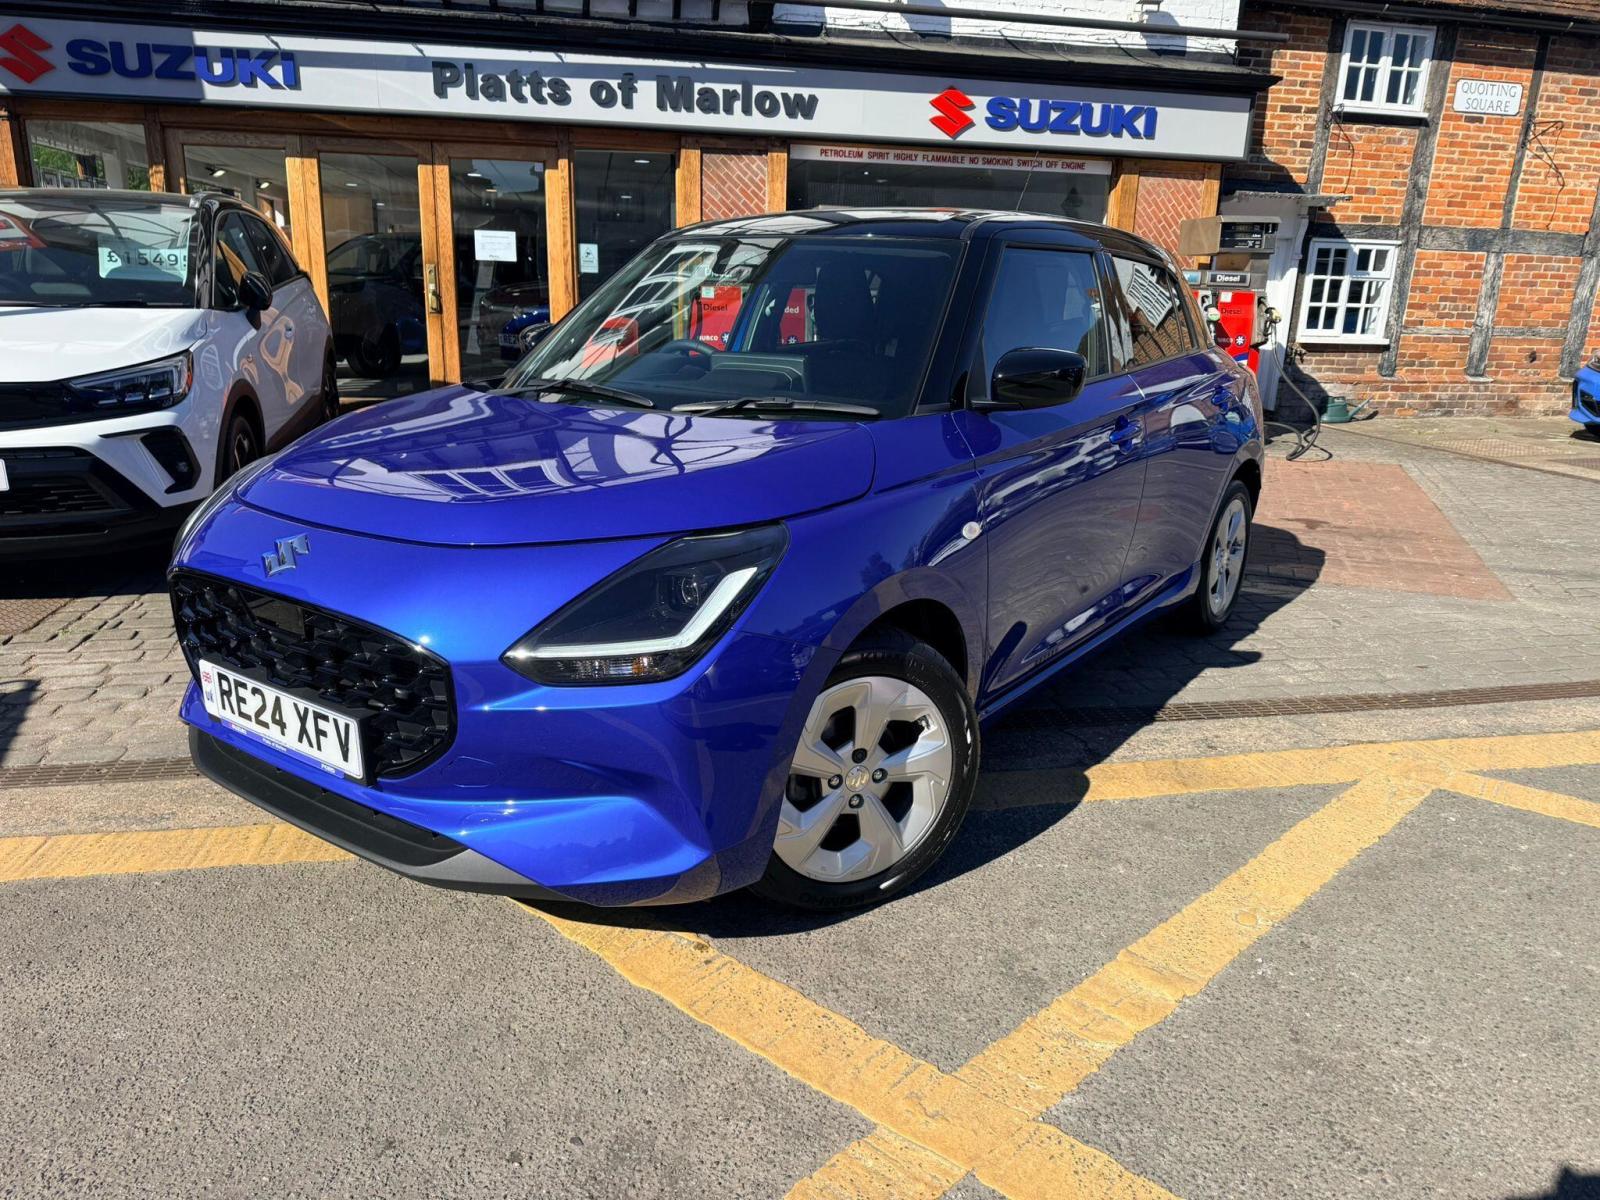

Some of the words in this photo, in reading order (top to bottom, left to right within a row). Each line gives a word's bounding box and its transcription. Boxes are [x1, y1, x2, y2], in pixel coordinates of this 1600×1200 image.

[66, 39, 300, 90] SUZUKI
[432, 61, 571, 105] Platts
[590, 72, 638, 109] of
[656, 75, 819, 120] Marlow
[1461, 82, 1517, 98] QUOITING
[1465, 98, 1511, 112] SQUARE
[985, 96, 1158, 140] SUZUKI
[820, 148, 864, 159] PETROLEUM
[868, 151, 890, 160] SPIRIT
[894, 152, 919, 162] HIGHLY
[922, 154, 966, 165] FLAMMABLE
[969, 156, 979, 165] NO
[982, 157, 1014, 167] SMOKING
[1017, 159, 1043, 168] SWITCH
[1046, 161, 1058, 169] OFF
[1061, 161, 1087, 170] ENGINE
[1216, 274, 1240, 282] Diesel
[703, 303, 728, 311] Diesel
[217, 672, 287, 737] RE24
[293, 702, 350, 763] XFV
